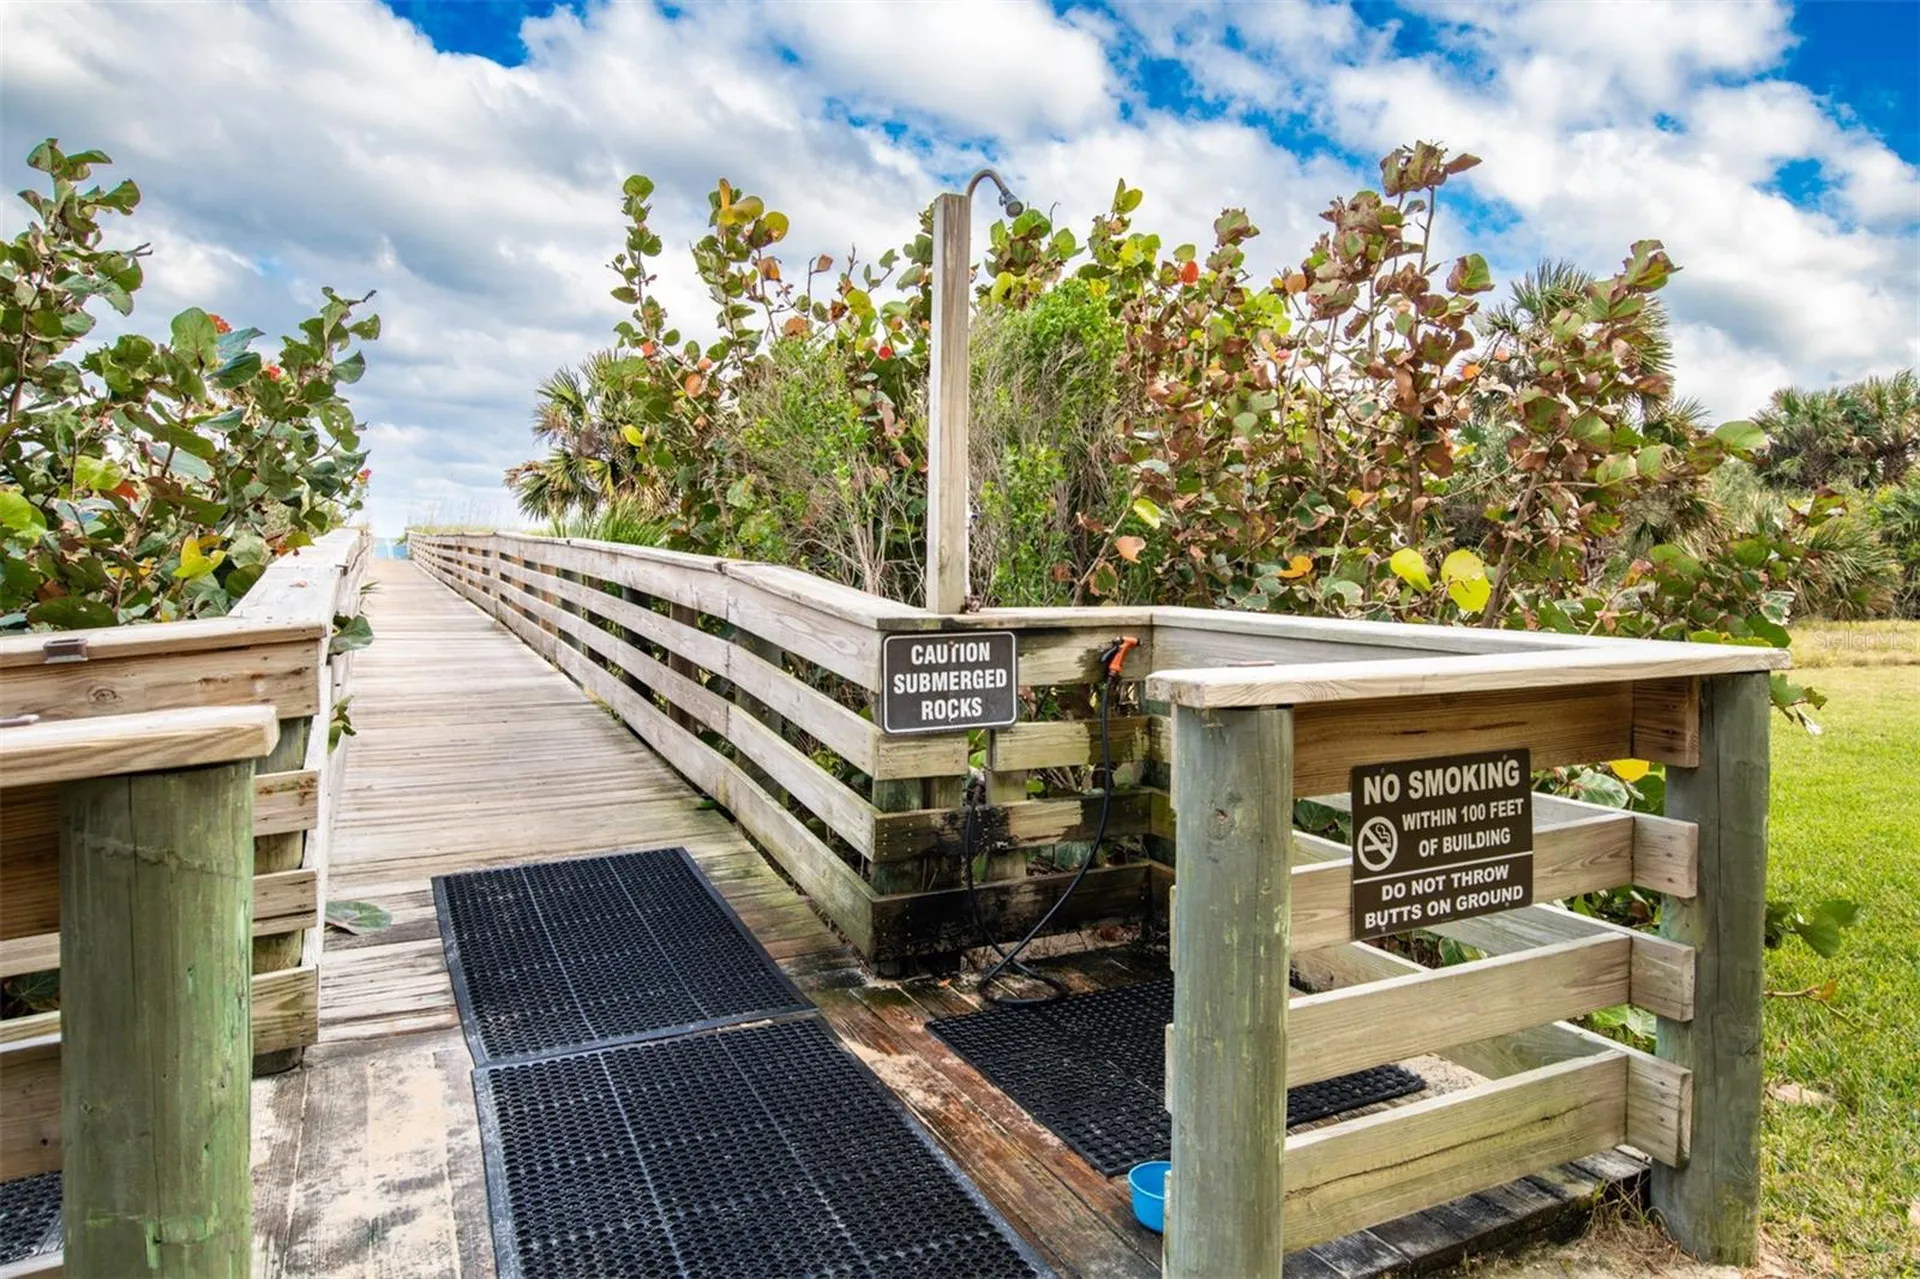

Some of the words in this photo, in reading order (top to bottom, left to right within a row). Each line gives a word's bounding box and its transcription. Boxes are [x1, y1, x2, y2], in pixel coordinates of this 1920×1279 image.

[911, 642, 991, 665] CAUTION
[893, 668, 1008, 694] SUBMERGED
[921, 697, 982, 721] ROCKS
[1363, 773, 1400, 805] NO
[1408, 759, 1520, 799] SMOKING
[1402, 807, 1457, 831] WITHIN
[1461, 803, 1486, 823] 100
[1489, 798, 1524, 818] FEET
[1418, 838, 1439, 857] OF
[1442, 827, 1511, 854] BUILDING
[1381, 882, 1406, 901] DO
[1411, 875, 1446, 896] NOT
[1450, 864, 1509, 888] THROW
[1364, 904, 1422, 929] BUTTS
[1427, 898, 1451, 917] ON
[1456, 885, 1524, 911] GROUND
